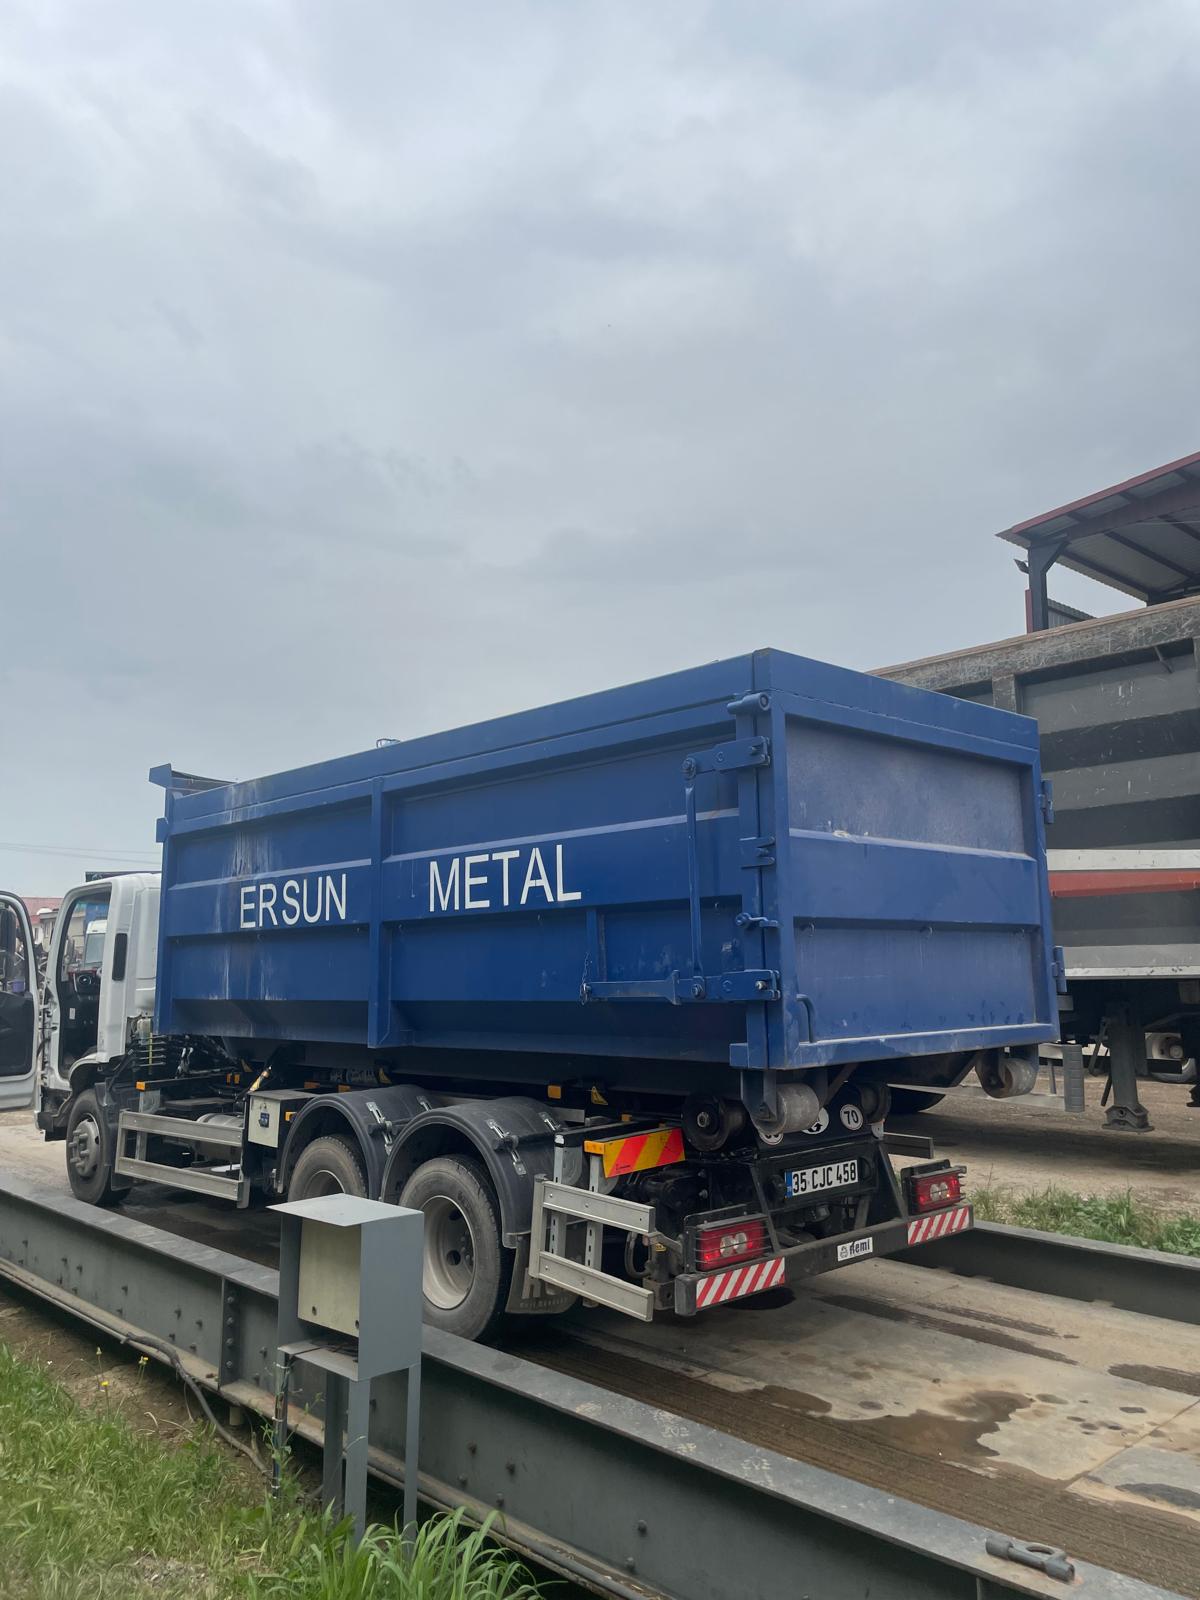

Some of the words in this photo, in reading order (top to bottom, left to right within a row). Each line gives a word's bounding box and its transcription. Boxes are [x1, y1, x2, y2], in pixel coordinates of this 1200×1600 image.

[240, 873, 347, 929] ERSUN
[429, 844, 582, 912] METAL
[843, 1109, 859, 1125] 70
[792, 1172, 807, 1194] 35
[811, 1166, 833, 1190] CJC
[836, 1161, 857, 1184] 458
